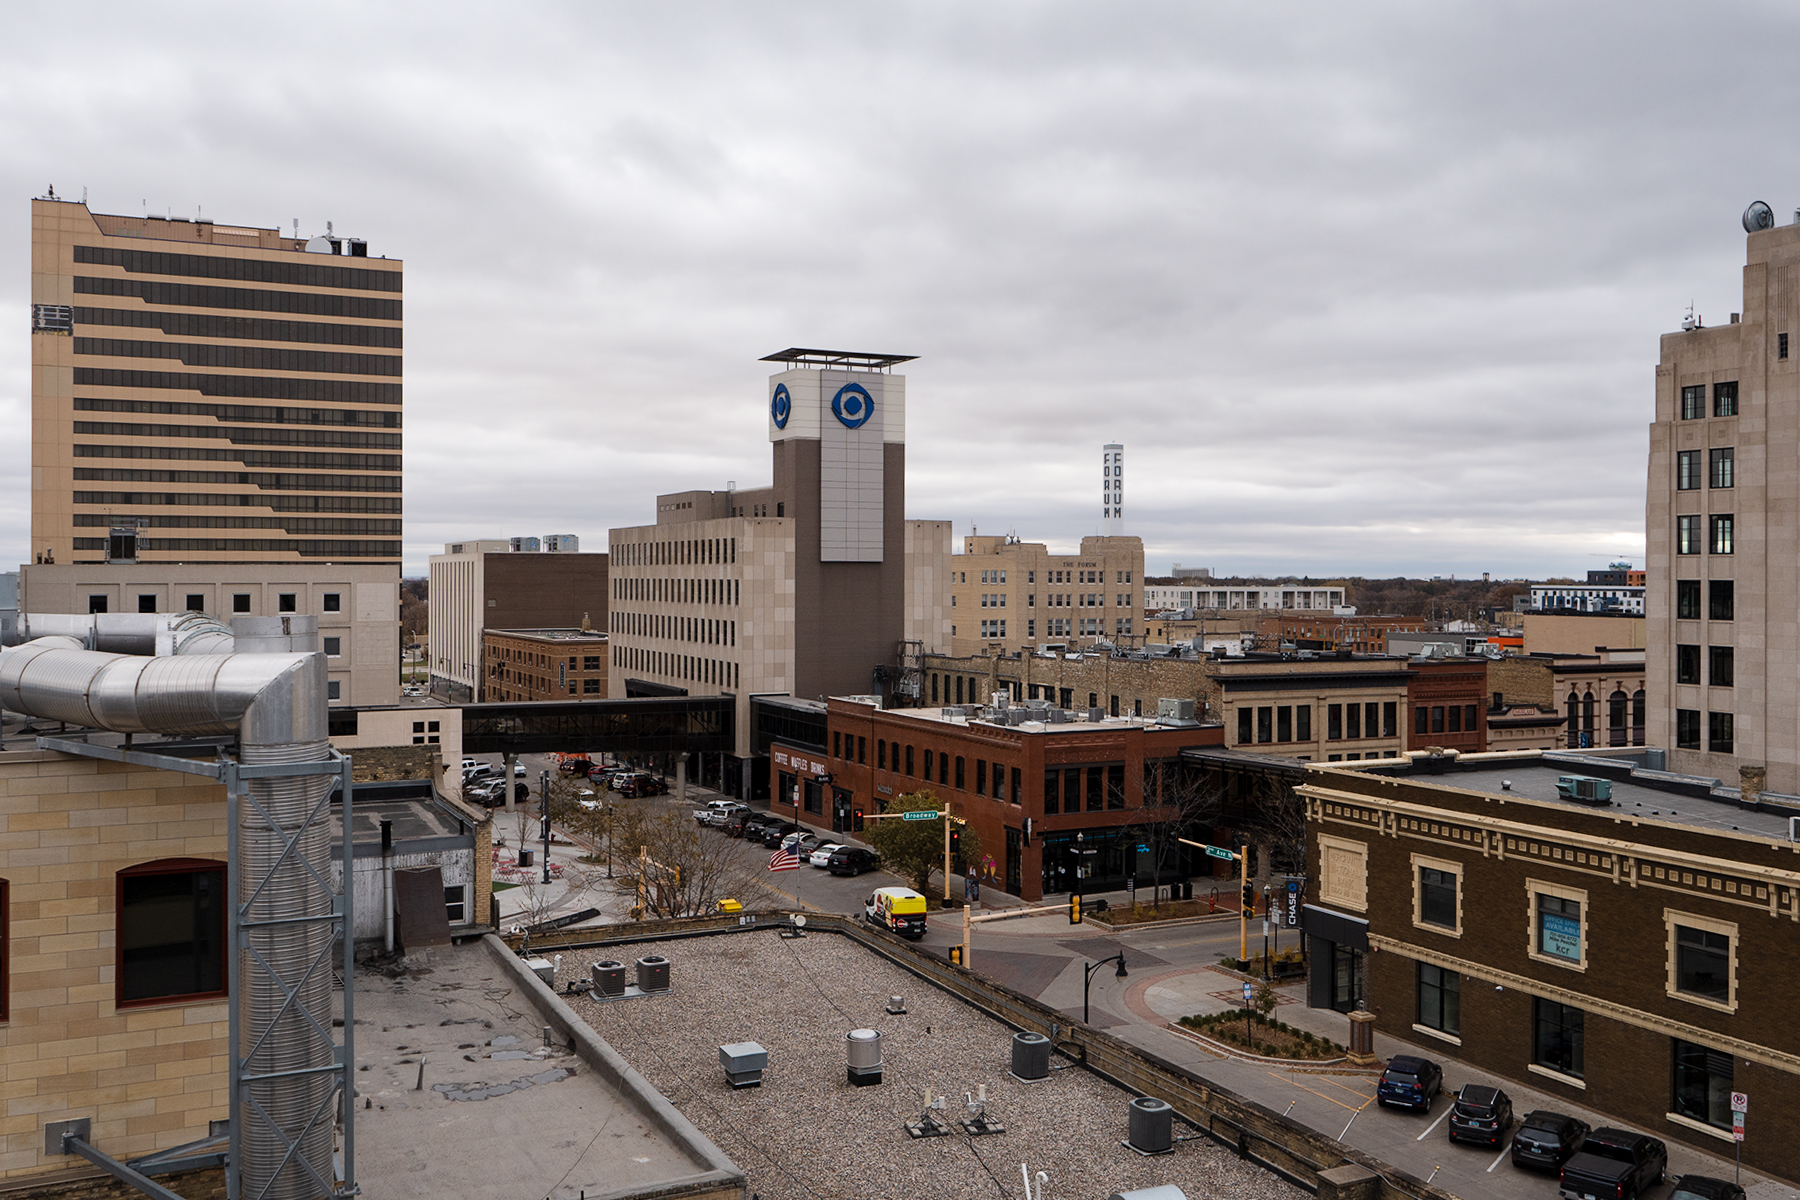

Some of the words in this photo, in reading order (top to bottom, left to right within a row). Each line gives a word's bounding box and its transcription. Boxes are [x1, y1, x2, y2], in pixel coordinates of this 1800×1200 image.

[774, 751, 788, 766] COFFEE
[810, 761, 825, 775] DRINKS
[1216, 849, 1226, 857] Ave
[1288, 892, 1297, 925] CHASE
[1544, 915, 1563, 925] OFFICE
[1555, 943, 1570, 955] kcr
